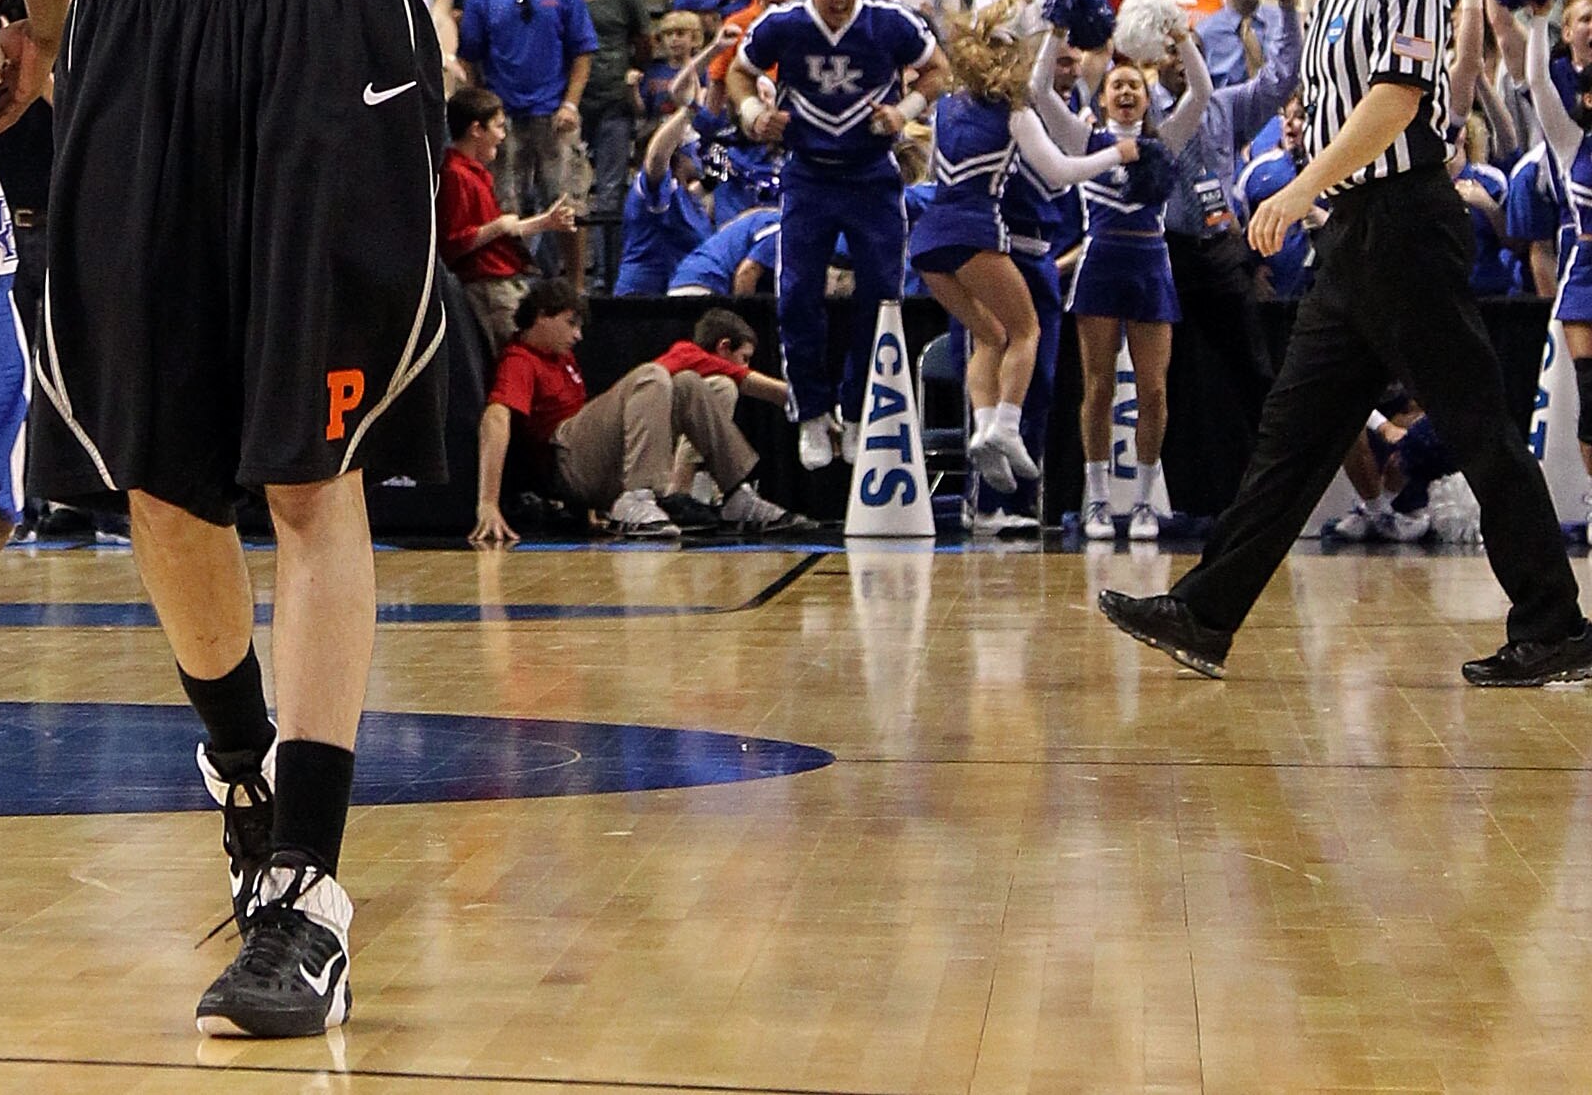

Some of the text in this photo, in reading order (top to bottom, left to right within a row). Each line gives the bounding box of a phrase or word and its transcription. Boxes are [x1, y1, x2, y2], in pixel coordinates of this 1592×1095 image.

[805, 55, 864, 94] UK
[326, 368, 365, 441] P
[859, 332, 918, 507] CATS
